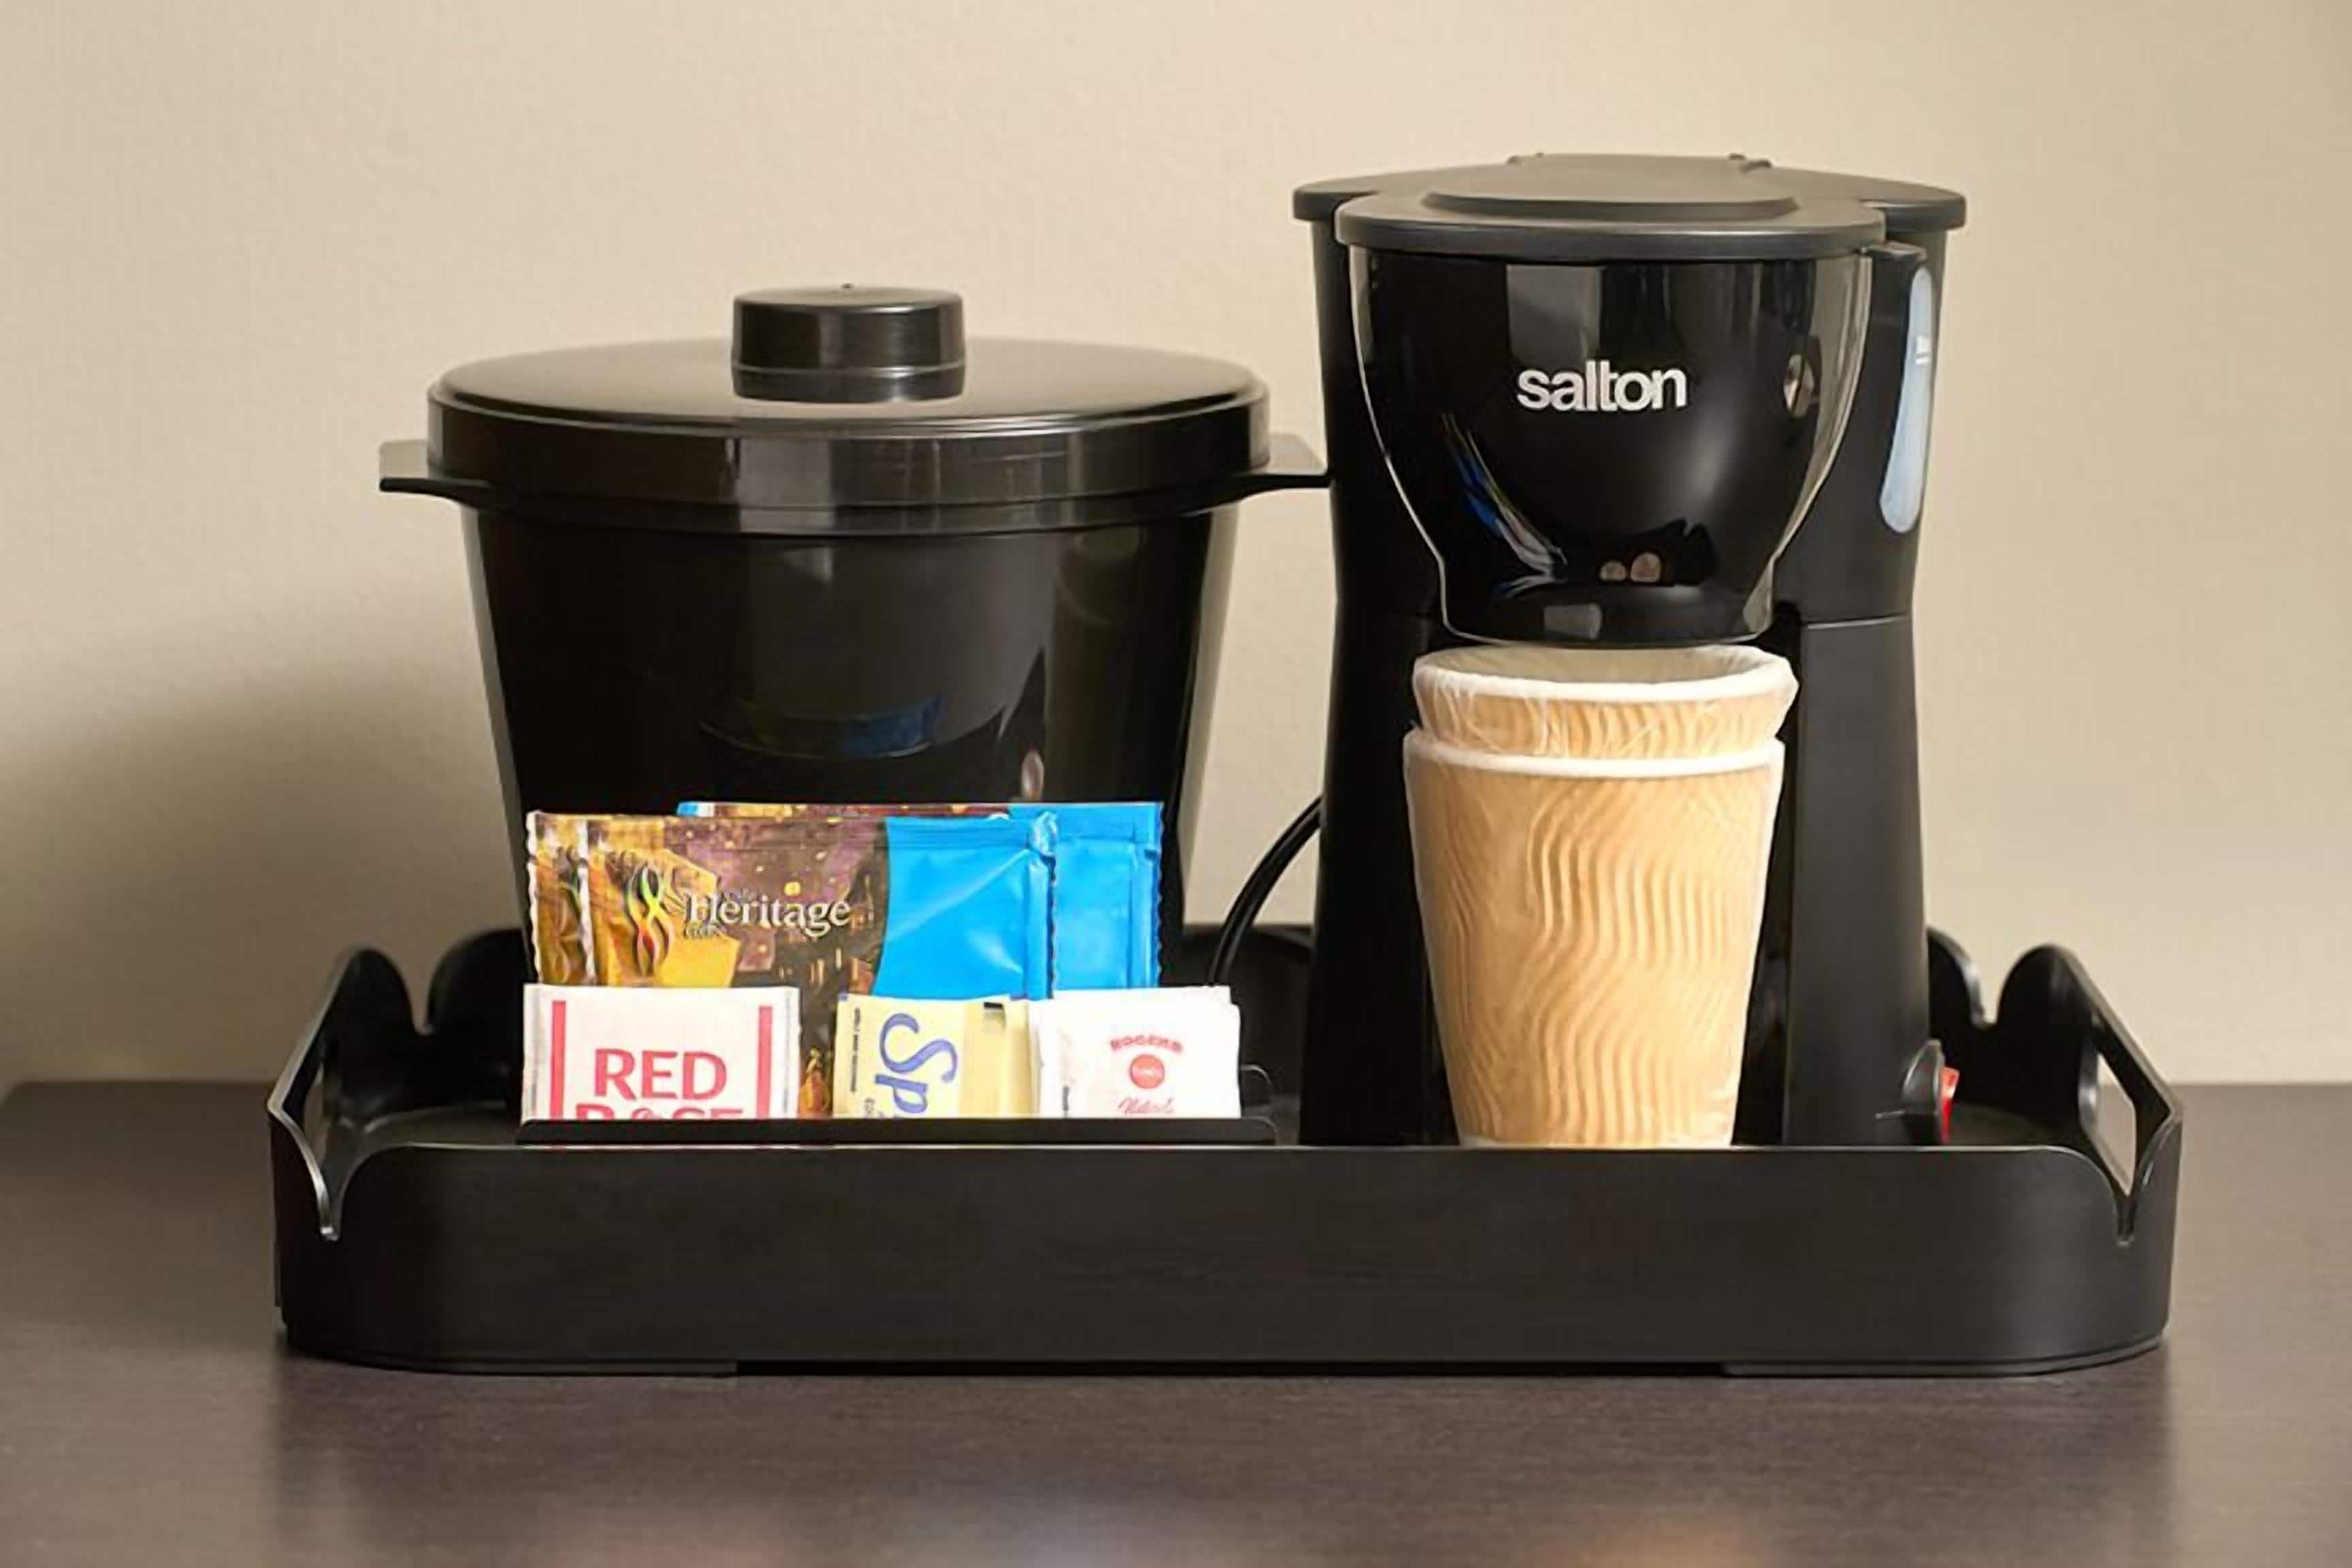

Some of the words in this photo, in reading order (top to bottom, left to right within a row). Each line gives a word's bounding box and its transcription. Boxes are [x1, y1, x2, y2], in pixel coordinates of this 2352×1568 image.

[1517, 359, 1687, 411] salton
[686, 892, 850, 937] Heritage
[594, 1048, 727, 1100] RED
[875, 1013, 958, 1118] Sp
